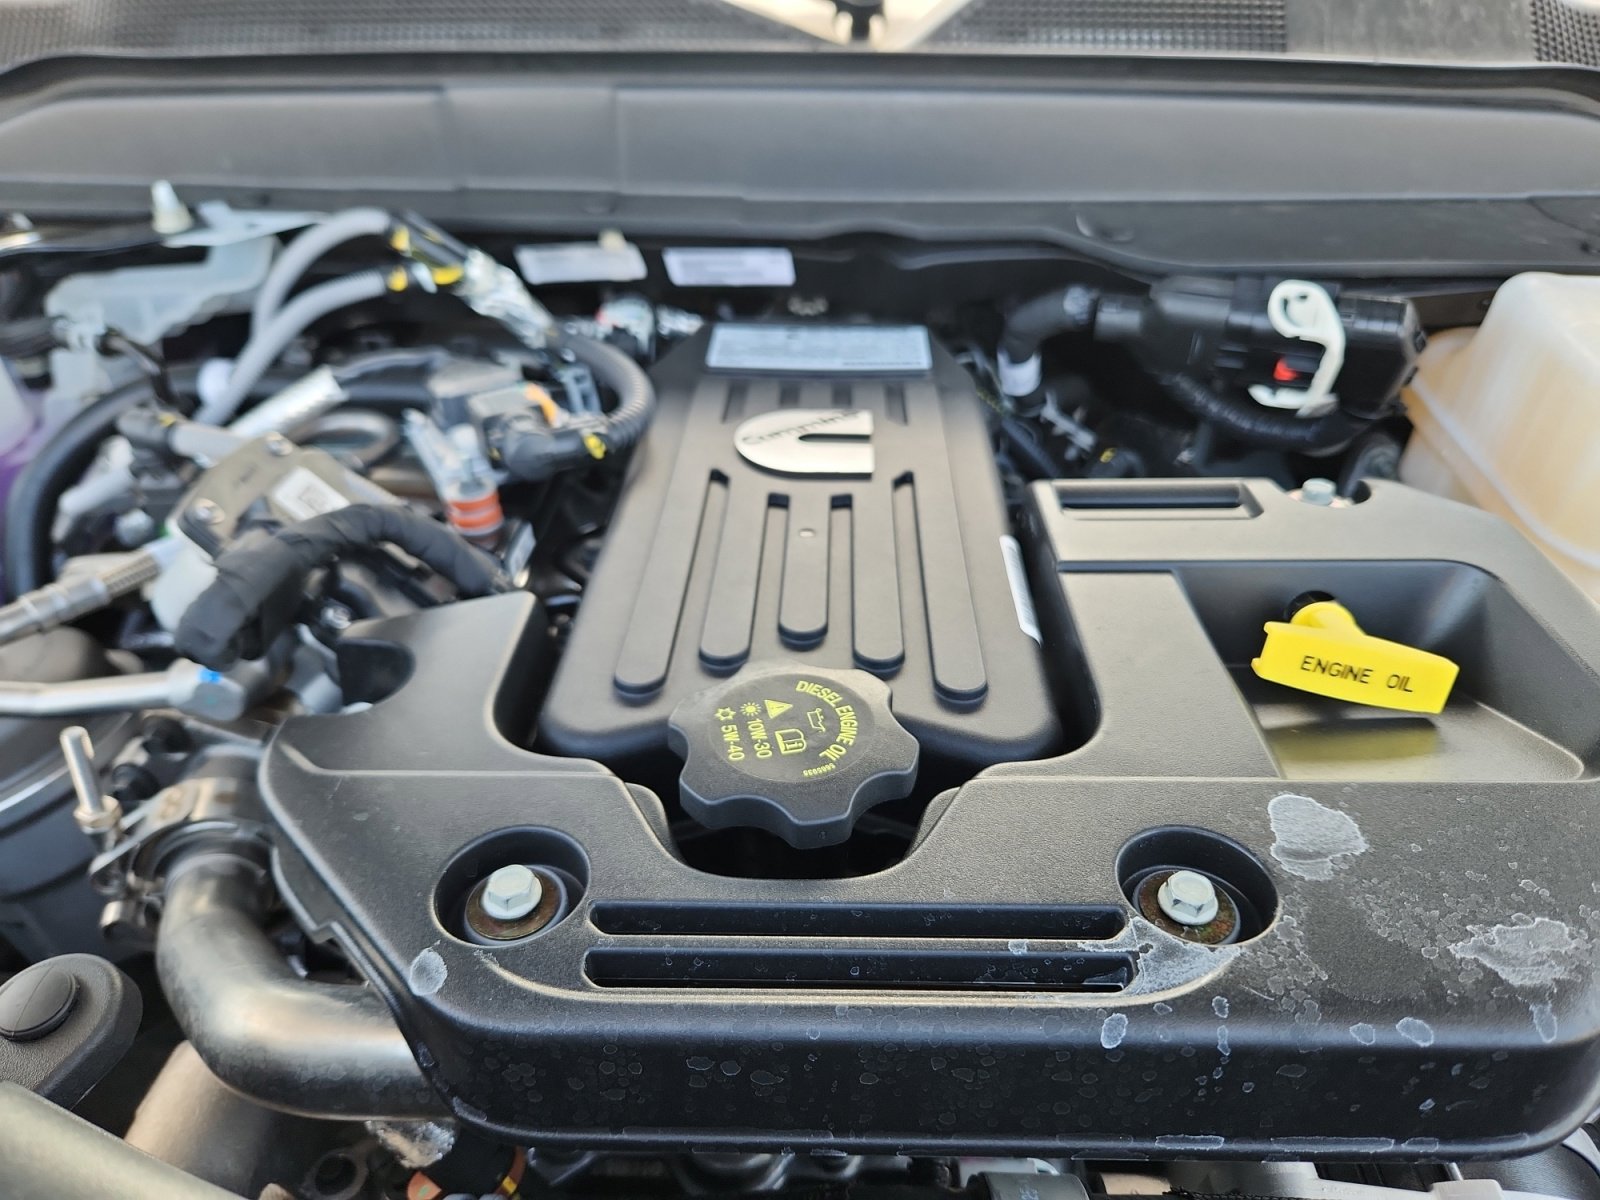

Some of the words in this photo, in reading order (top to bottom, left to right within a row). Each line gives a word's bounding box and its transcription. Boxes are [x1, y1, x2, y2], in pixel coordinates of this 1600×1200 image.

[1300, 655, 1374, 685] ENGINE
[1386, 674, 1413, 693] OIL
[795, 680, 843, 708] DIESEL
[720, 724, 745, 761] 5W-40
[746, 718, 773, 759] 10W-30
[835, 704, 858, 746] ENGINE
[818, 744, 847, 761] OIL
